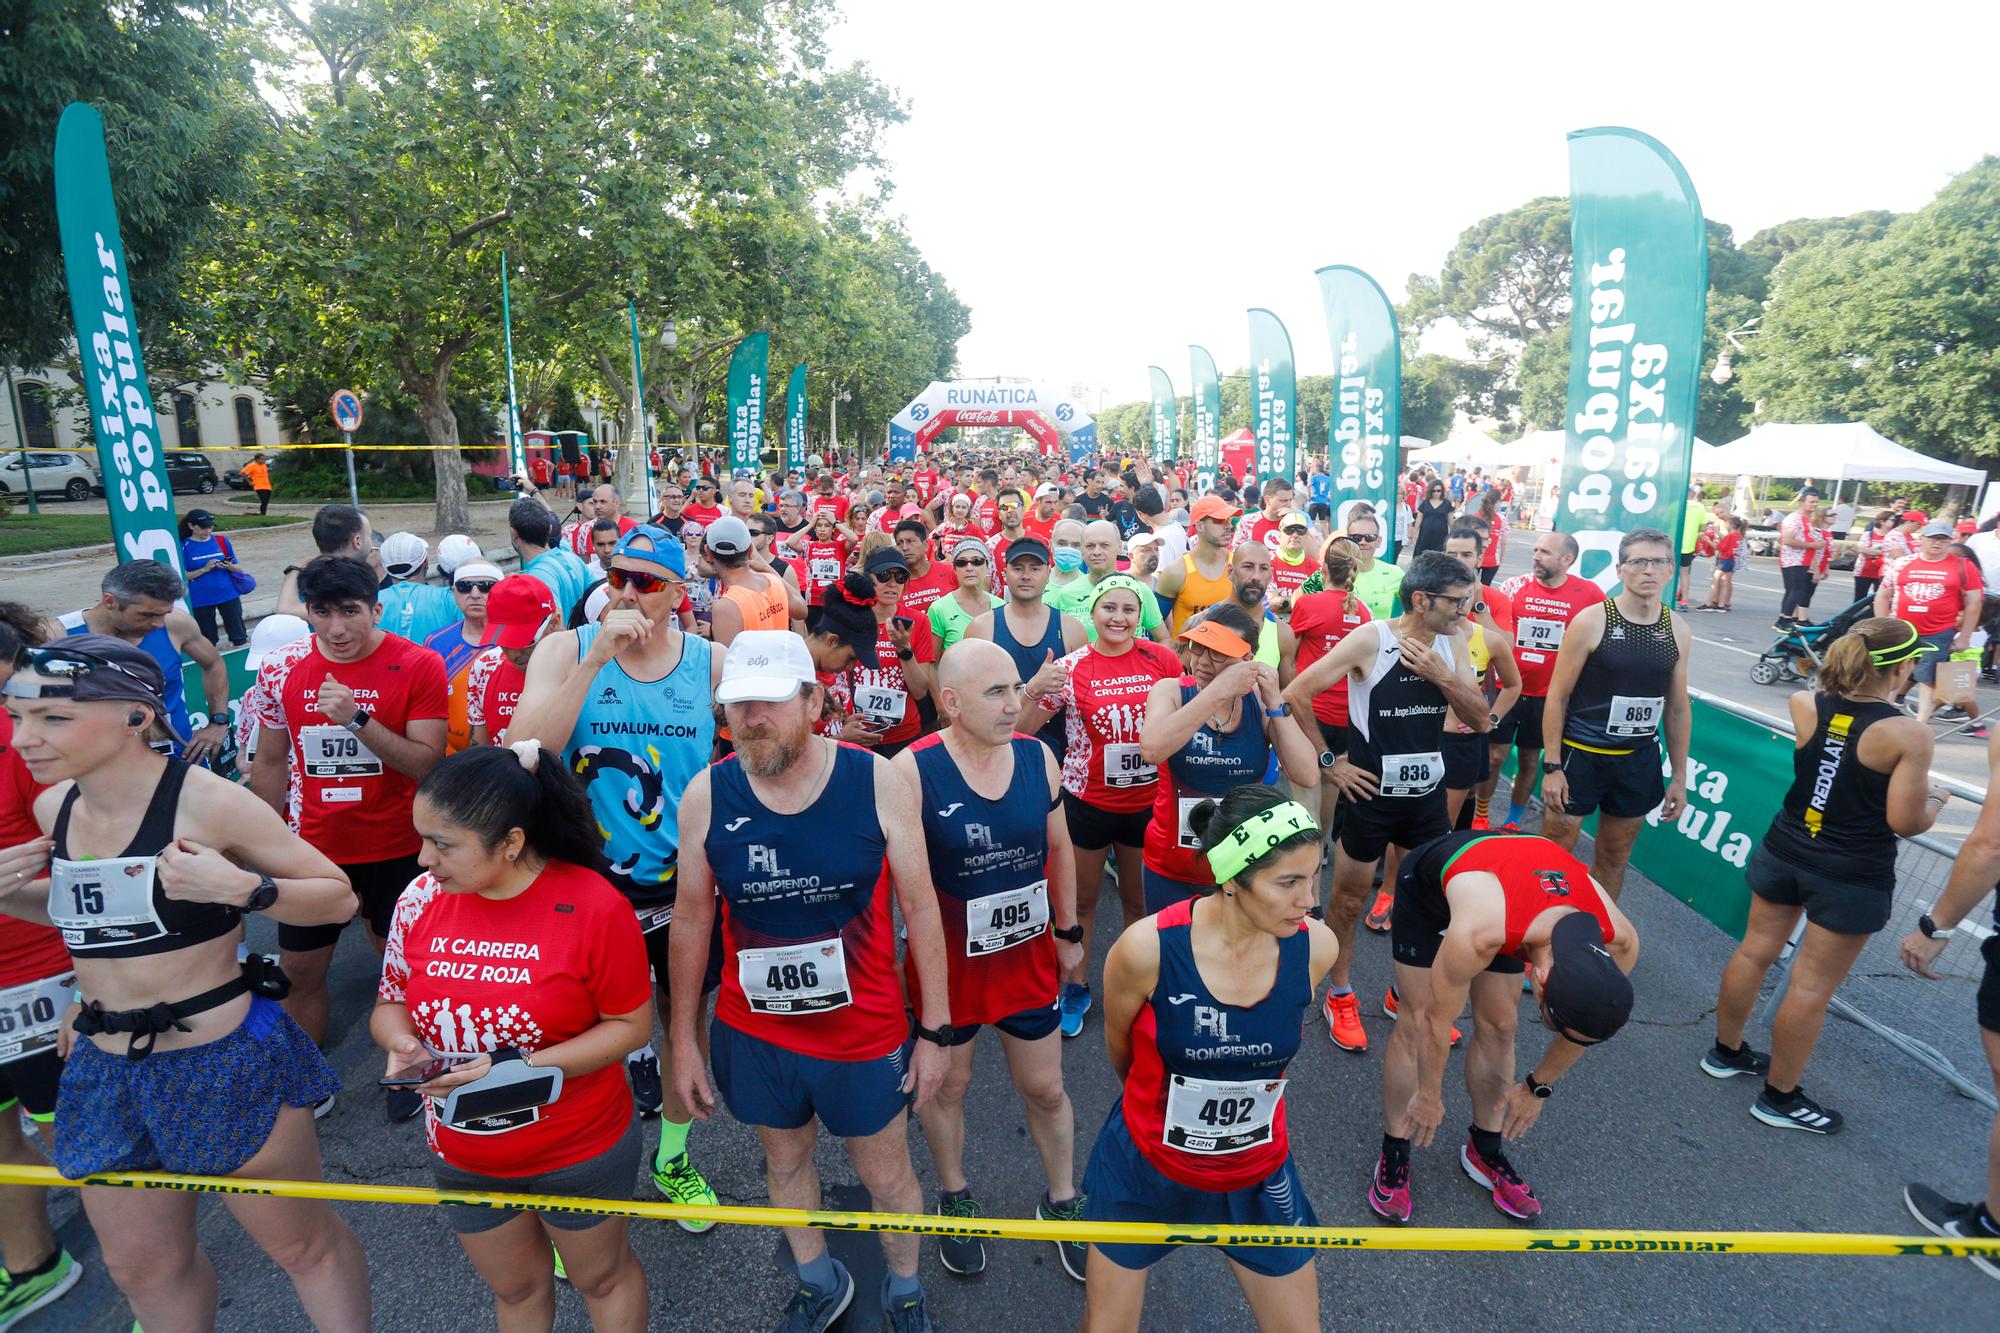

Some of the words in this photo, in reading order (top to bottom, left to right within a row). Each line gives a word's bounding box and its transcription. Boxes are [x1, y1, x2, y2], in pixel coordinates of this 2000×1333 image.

[95, 232, 168, 512] popular
[947, 387, 1038, 404] RUNÁTICA
[94, 331, 138, 513] caixa
[956, 409, 1000, 424] Coca-Cola
[733, 405, 748, 463] caixa
[819, 564, 833, 573] 250
[904, 599, 922, 607] CRUZ
[923, 594, 941, 604] ROJA
[909, 587, 941, 599] CARRERA
[1525, 604, 1547, 612] CRUZ
[1547, 607, 1568, 617] ROJA
[1534, 597, 1571, 609] CARRERA
[1531, 626, 1551, 639] 737
[747, 655, 769, 667] edp
[1090, 679, 1101, 688] IX
[1103, 673, 1153, 687] CARRERA
[303, 689, 316, 699] IX
[498, 692, 508, 702] IX
[1094, 687, 1124, 697] CRUZ
[868, 694, 892, 711] 728
[1625, 707, 1653, 722] 889
[590, 721, 697, 739] TUVALUM.COM
[321, 737, 359, 758] 579
[1185, 755, 1242, 766] ROMPIENDO
[1399, 764, 1430, 782] 838
[1810, 737, 1846, 812] REDOLAT
[964, 847, 1025, 868] ROMPIENDO
[742, 875, 820, 895] ROMPIENDO
[71, 882, 104, 915] 15
[803, 892, 841, 905] LIMITES
[990, 901, 1030, 930] 495
[430, 937, 449, 953] IX
[451, 938, 540, 961] CARRERA
[426, 960, 480, 980] CRUZ
[480, 965, 532, 985] ROJA
[766, 961, 819, 992] 486
[0, 996, 55, 1034] 610
[1185, 1042, 1273, 1061] ROMPIENDO
[1198, 1097, 1255, 1127] 492
[1187, 1139, 1215, 1148] 42K
[1588, 1239, 1734, 1252] popular
